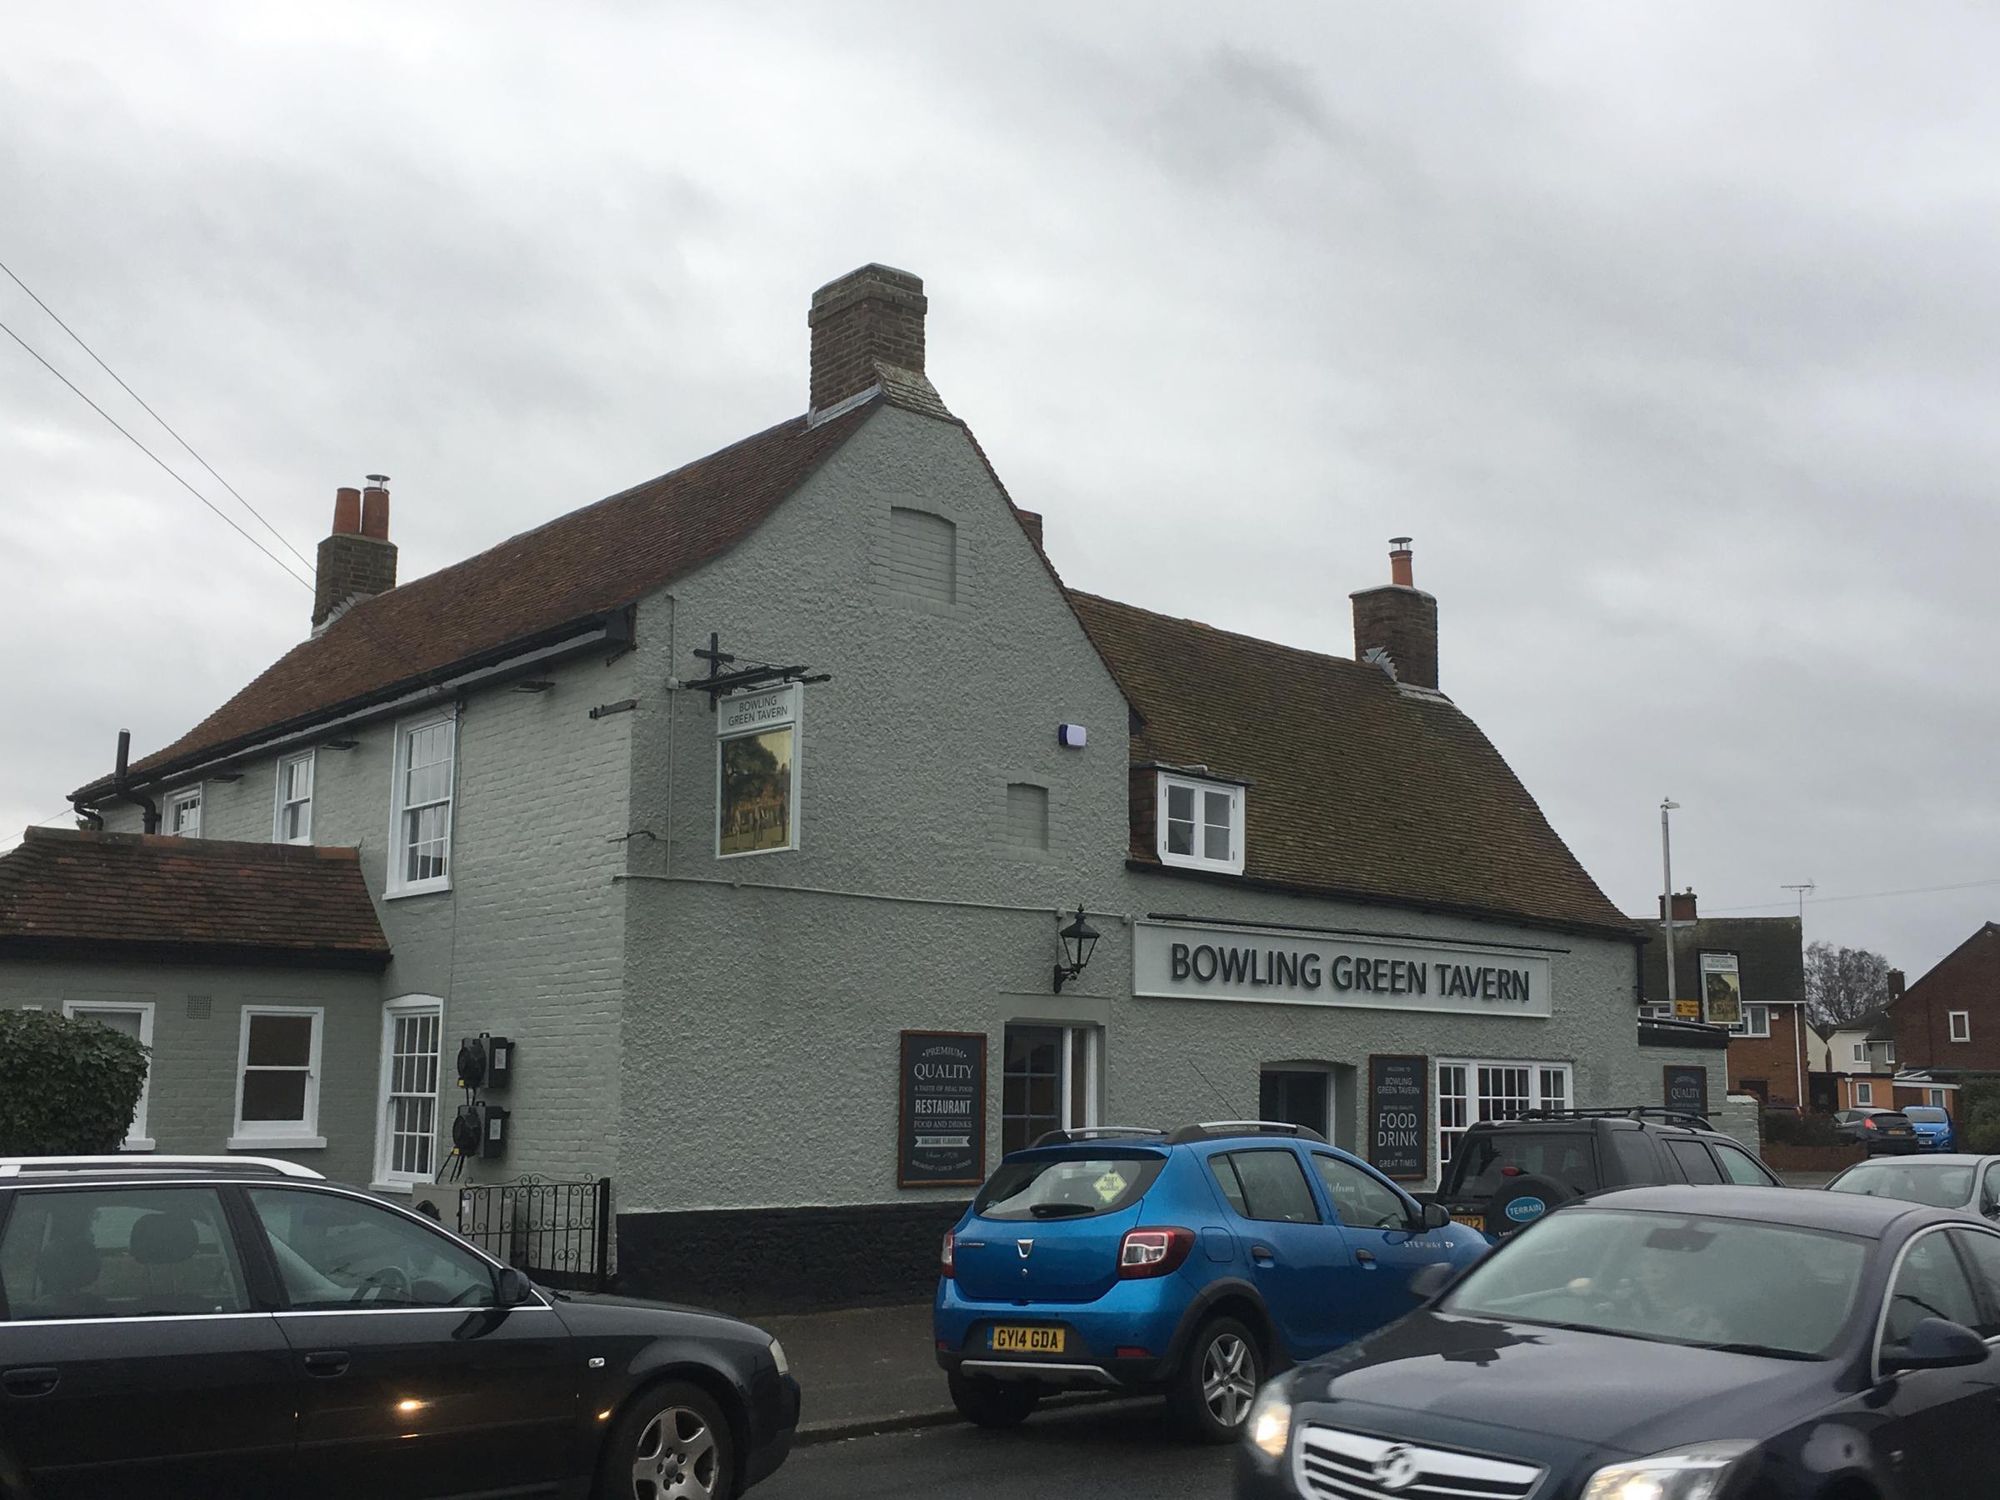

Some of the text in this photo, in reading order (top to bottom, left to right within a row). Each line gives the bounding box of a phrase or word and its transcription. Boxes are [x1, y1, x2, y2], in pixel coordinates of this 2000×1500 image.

[739, 695, 777, 713] BOWLING
[728, 705, 788, 727] GREEN TAVERN
[1171, 943, 1531, 1002] BOWLING GREEN TAVERN
[925, 1046, 964, 1059] PREMIUM
[914, 1062, 974, 1081] QUALITY
[1384, 1077, 1413, 1086] BOWLING
[1377, 1085, 1420, 1095] GREEN TAVERN
[1671, 1087, 1700, 1100] QUALITY
[914, 1099, 972, 1114] RESTAURANT
[913, 1120, 973, 1129] FOOD AND DRINKS
[1379, 1112, 1417, 1129] FOOD
[1377, 1131, 1418, 1147] DRINK
[1378, 1159, 1417, 1168] GREAT TIMES
[1508, 1203, 1542, 1216] TERRAIN
[997, 1329, 1059, 1349] GY14 GDA
